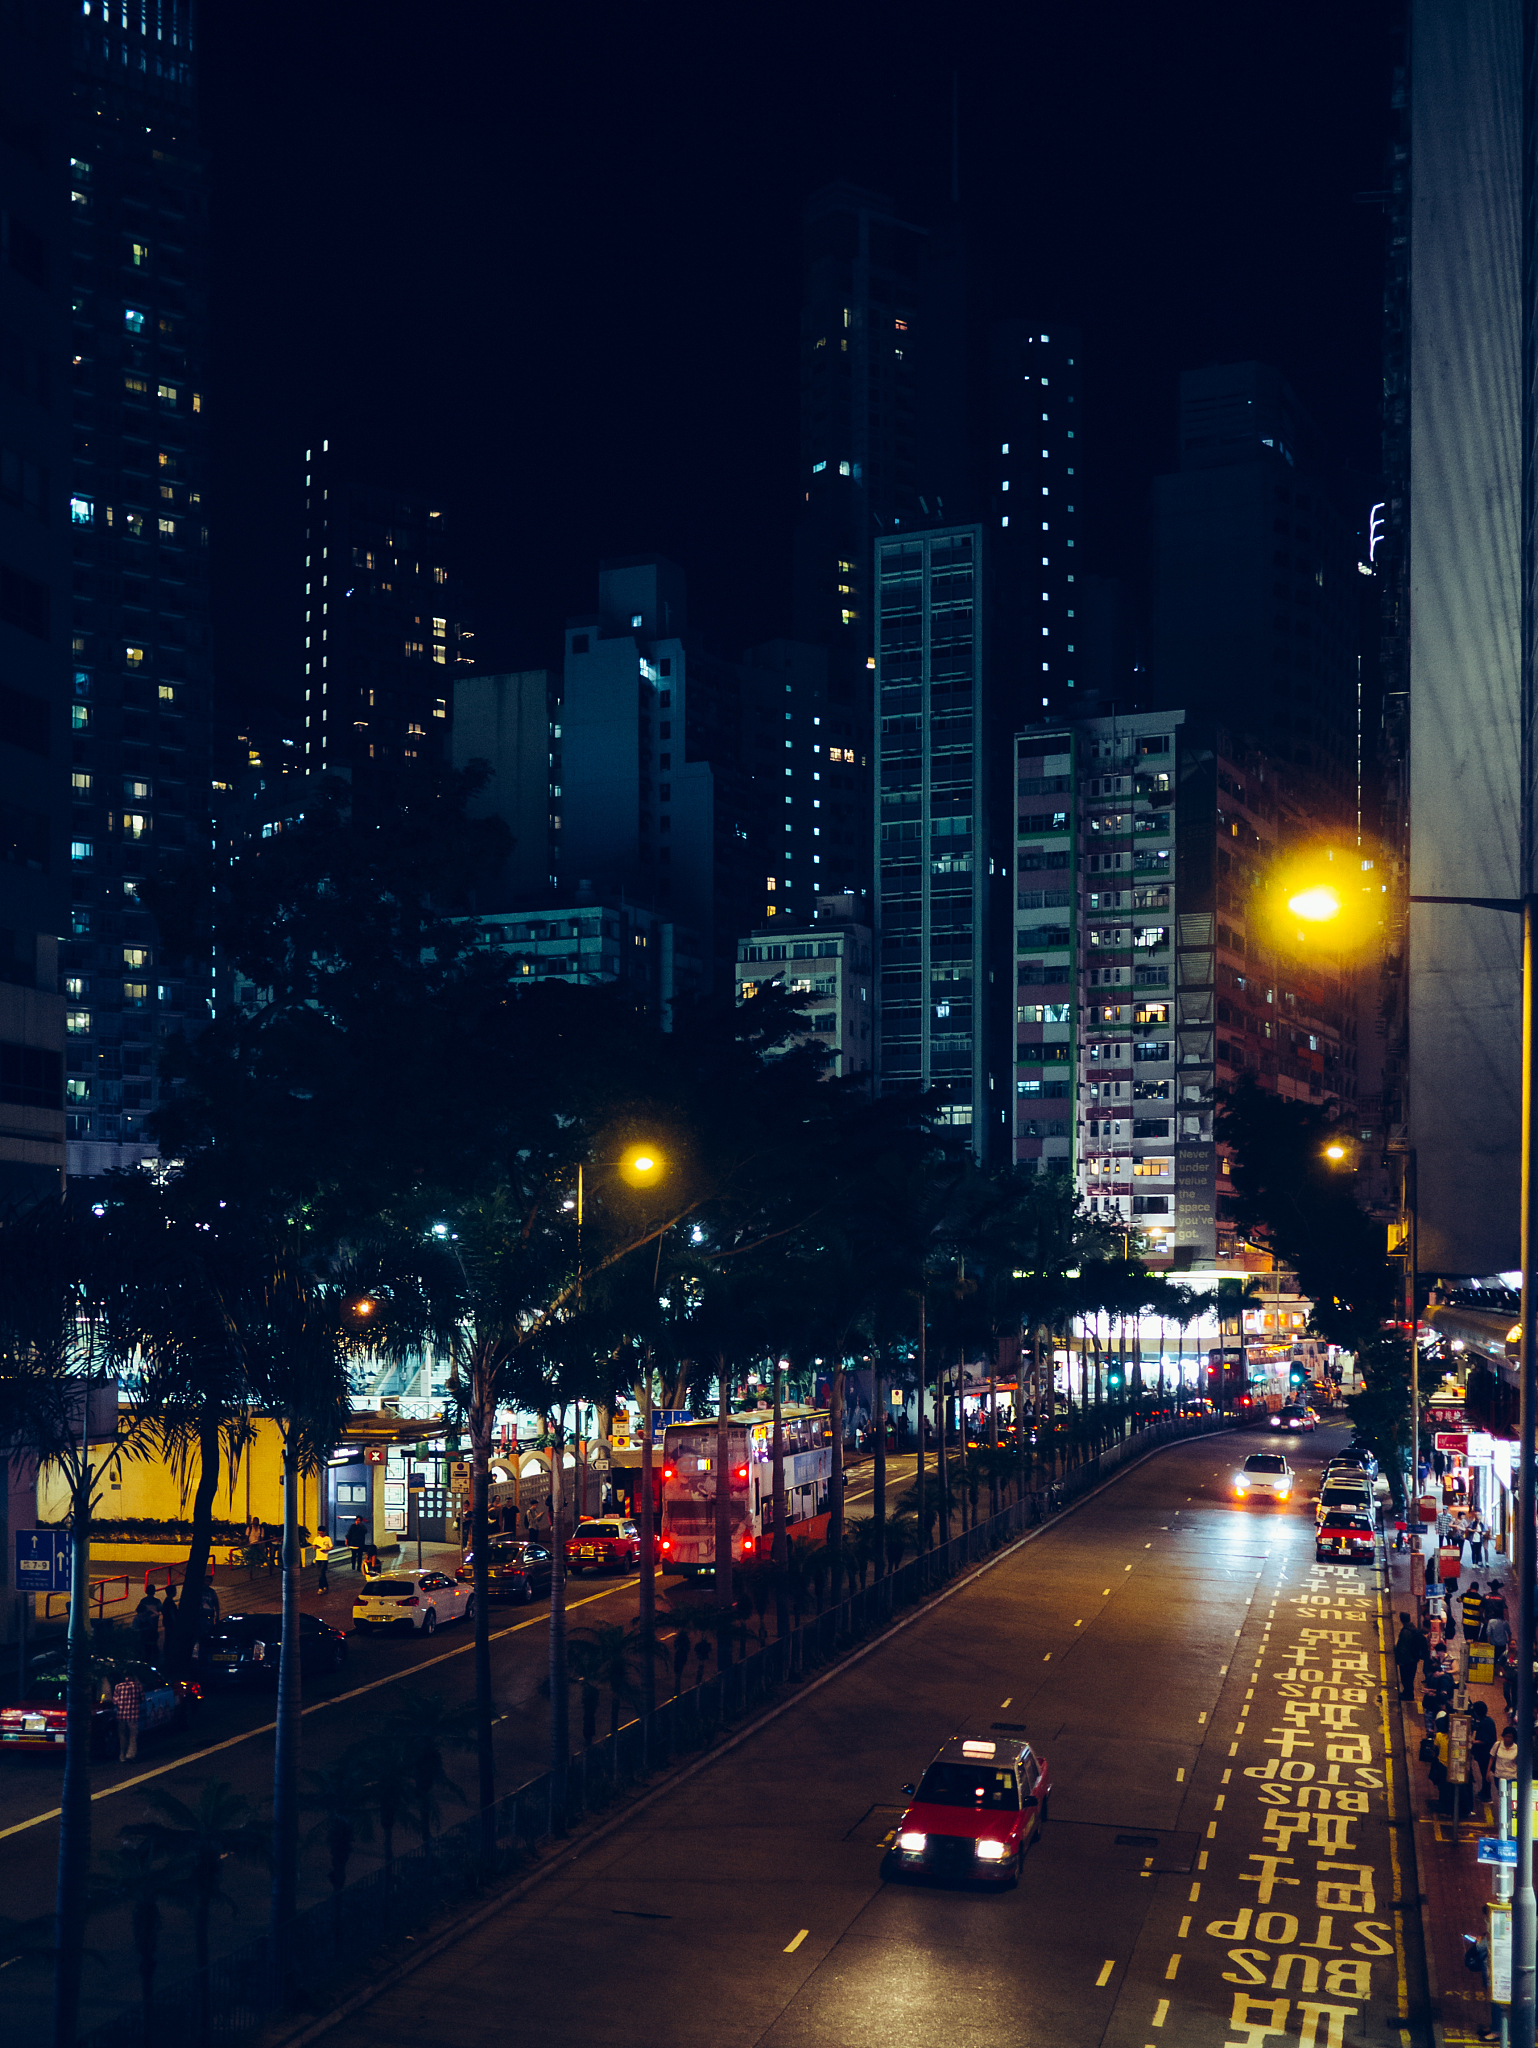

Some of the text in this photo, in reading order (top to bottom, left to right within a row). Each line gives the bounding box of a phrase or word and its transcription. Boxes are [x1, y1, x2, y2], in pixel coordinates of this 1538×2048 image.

[1179, 1150, 1209, 1159] Never
[1179, 1163, 1210, 1172] under
[1178, 1177, 1208, 1185] value
[1178, 1190, 1196, 1199] the
[1179, 1203, 1210, 1213] space
[1178, 1216, 1214, 1227] you've
[1178, 1230, 1199, 1240] got.
[1300, 1578, 1366, 1596] 巴士
[1289, 1594, 1373, 1608] STOP
[1296, 1607, 1367, 1622] BUS
[1282, 1645, 1369, 1671] 巴士
[1273, 1667, 1377, 1687] STOP
[1277, 1683, 1368, 1703] BUS
[1263, 1728, 1373, 1764] 巴士
[1243, 1758, 1384, 1789] STOP
[1257, 1782, 1370, 1813] BUS
[1238, 1854, 1376, 1914] 巴士
[1205, 1907, 1395, 1956] STOP
[1221, 1948, 1372, 2000] BUS
